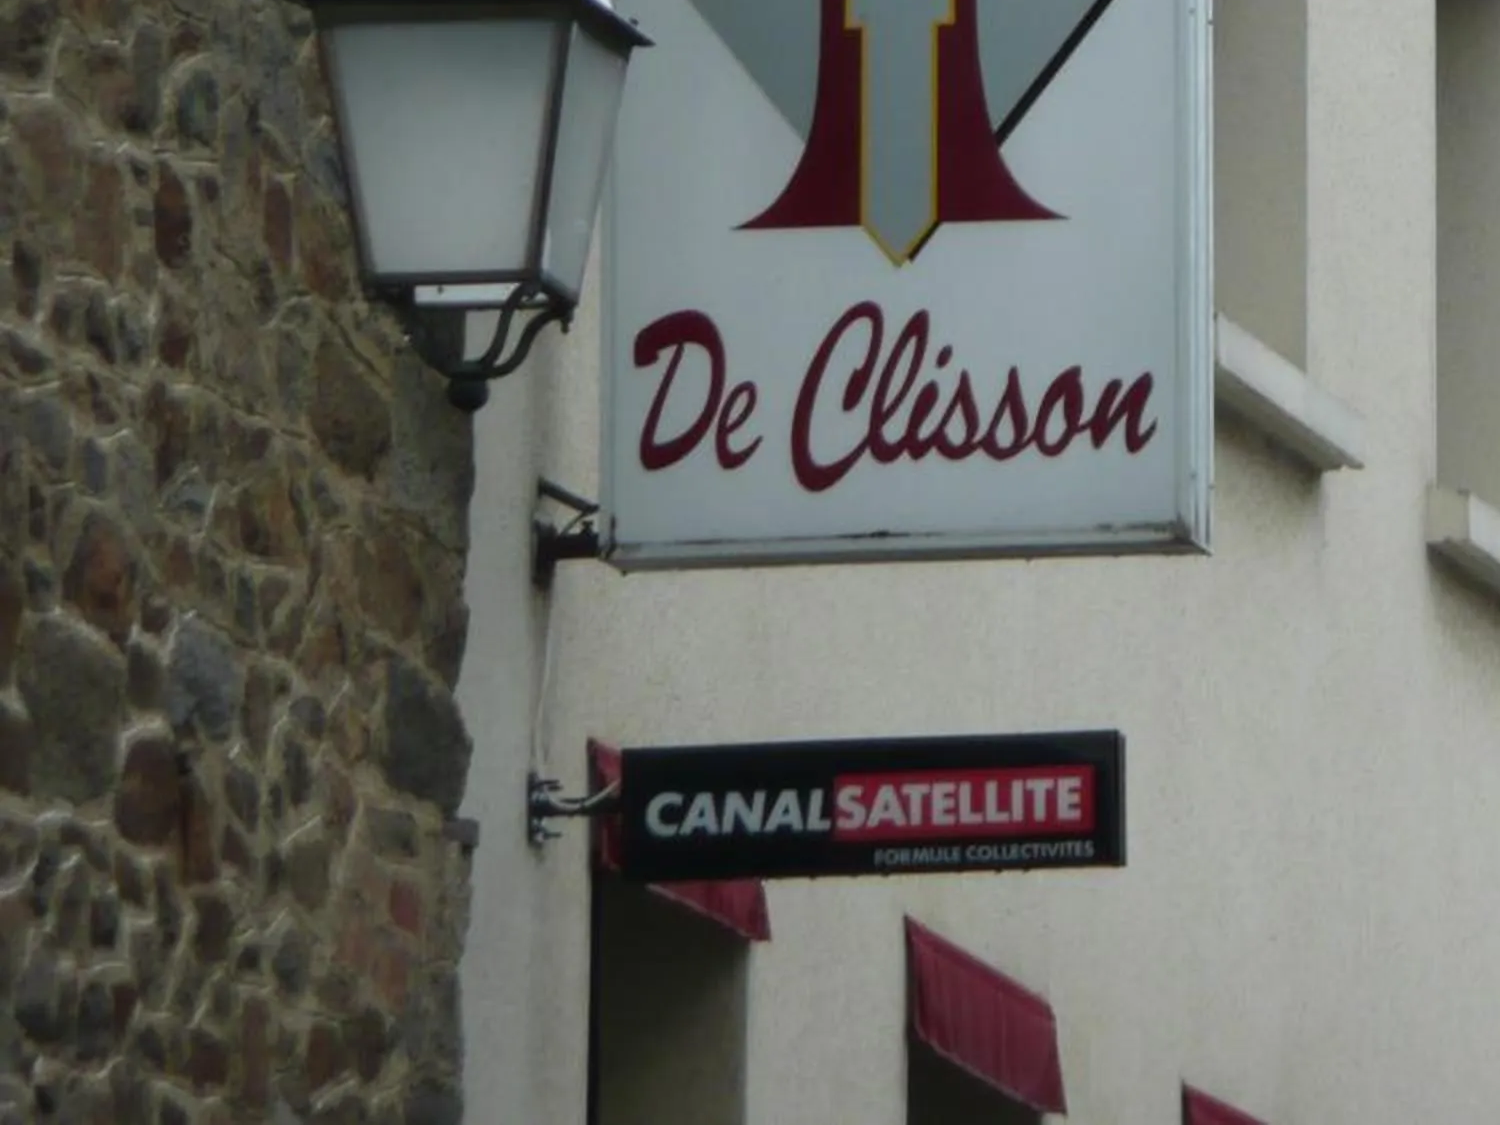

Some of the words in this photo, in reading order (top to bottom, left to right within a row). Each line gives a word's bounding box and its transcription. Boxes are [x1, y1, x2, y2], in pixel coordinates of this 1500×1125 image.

[633, 309, 762, 471] De
[791, 301, 1157, 493] Clisson
[874, 845, 962, 867] FORMULE
[966, 840, 1094, 862] COLLECTIVITES
